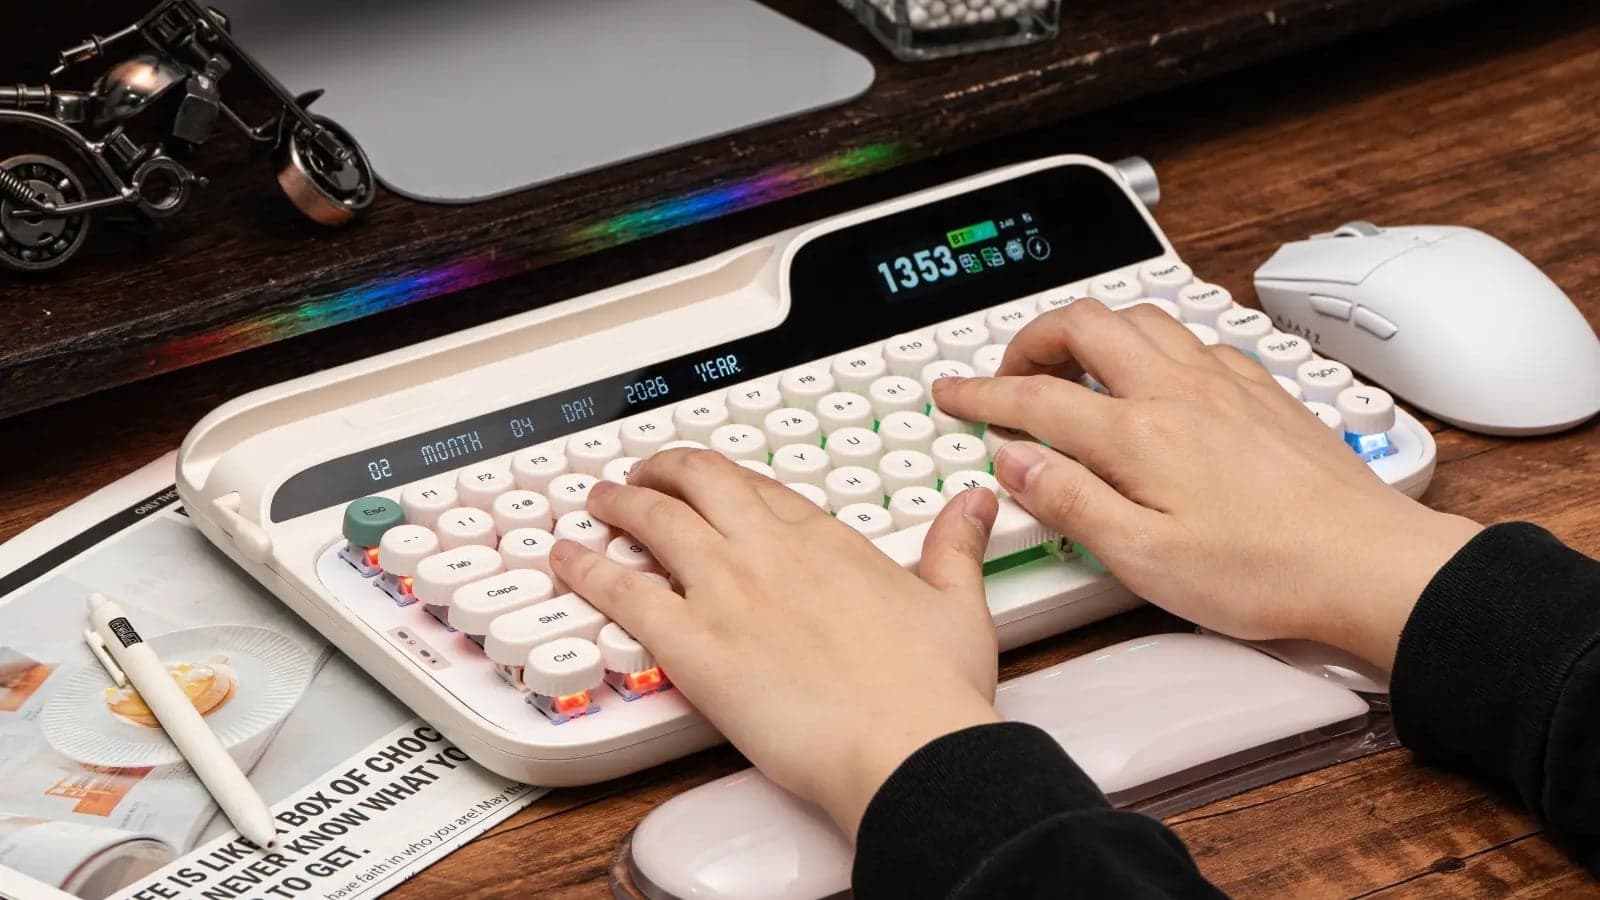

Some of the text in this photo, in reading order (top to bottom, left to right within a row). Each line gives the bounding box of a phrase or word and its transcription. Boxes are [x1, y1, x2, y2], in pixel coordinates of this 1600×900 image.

[878, 245, 958, 294] 1353
[1104, 280, 1126, 291] End
[1187, 289, 1220, 301] Home
[1000, 311, 1025, 322] F12
[951, 327, 974, 337] F11
[899, 342, 923, 352] F10
[1267, 339, 1299, 352] PgUp
[850, 359, 867, 368] F9
[798, 375, 816, 384] F8
[745, 390, 761, 400] F7
[693, 407, 710, 416] F6
[367, 458, 393, 480] 02
[420, 431, 483, 465] MONTH
[510, 417, 535, 438] 04
[561, 397, 595, 424] DAY
[695, 354, 741, 383] YEAR
[638, 423, 656, 433] F5
[903, 421, 912, 429] I
[585, 439, 602, 449] F4
[846, 436, 861, 445] U
[952, 442, 967, 452] K
[531, 456, 548, 465] F3
[793, 452, 806, 461] Y
[904, 459, 912, 468] J
[477, 473, 495, 482] F2
[846, 477, 862, 486] H
[963, 479, 980, 489] M
[421, 489, 438, 499] F1
[911, 496, 927, 506] N
[134, 499, 160, 514] ONLY
[363, 506, 386, 516] Esc
[857, 514, 872, 522] B
[575, 519, 593, 529] W
[523, 538, 538, 546] Q
[630, 545, 643, 553] S
[446, 559, 472, 571] Tab
[487, 584, 519, 598] Caps
[538, 611, 569, 624] Shift
[553, 650, 578, 663] Ctrl
[166, 868, 207, 888] IS
[276, 791, 342, 827] BOX
[329, 768, 370, 795] OF
[200, 853, 297, 900] NEVER
[284, 807, 370, 855] KNOW
[358, 765, 440, 811] WHAT
[323, 881, 361, 900] have
[355, 864, 391, 883] faith
[384, 855, 404, 866] in
[401, 836, 433, 857] who
[430, 823, 457, 842] you
[455, 808, 482, 826] are!
[475, 793, 510, 812] May
[264, 845, 371, 899] TO GET.
